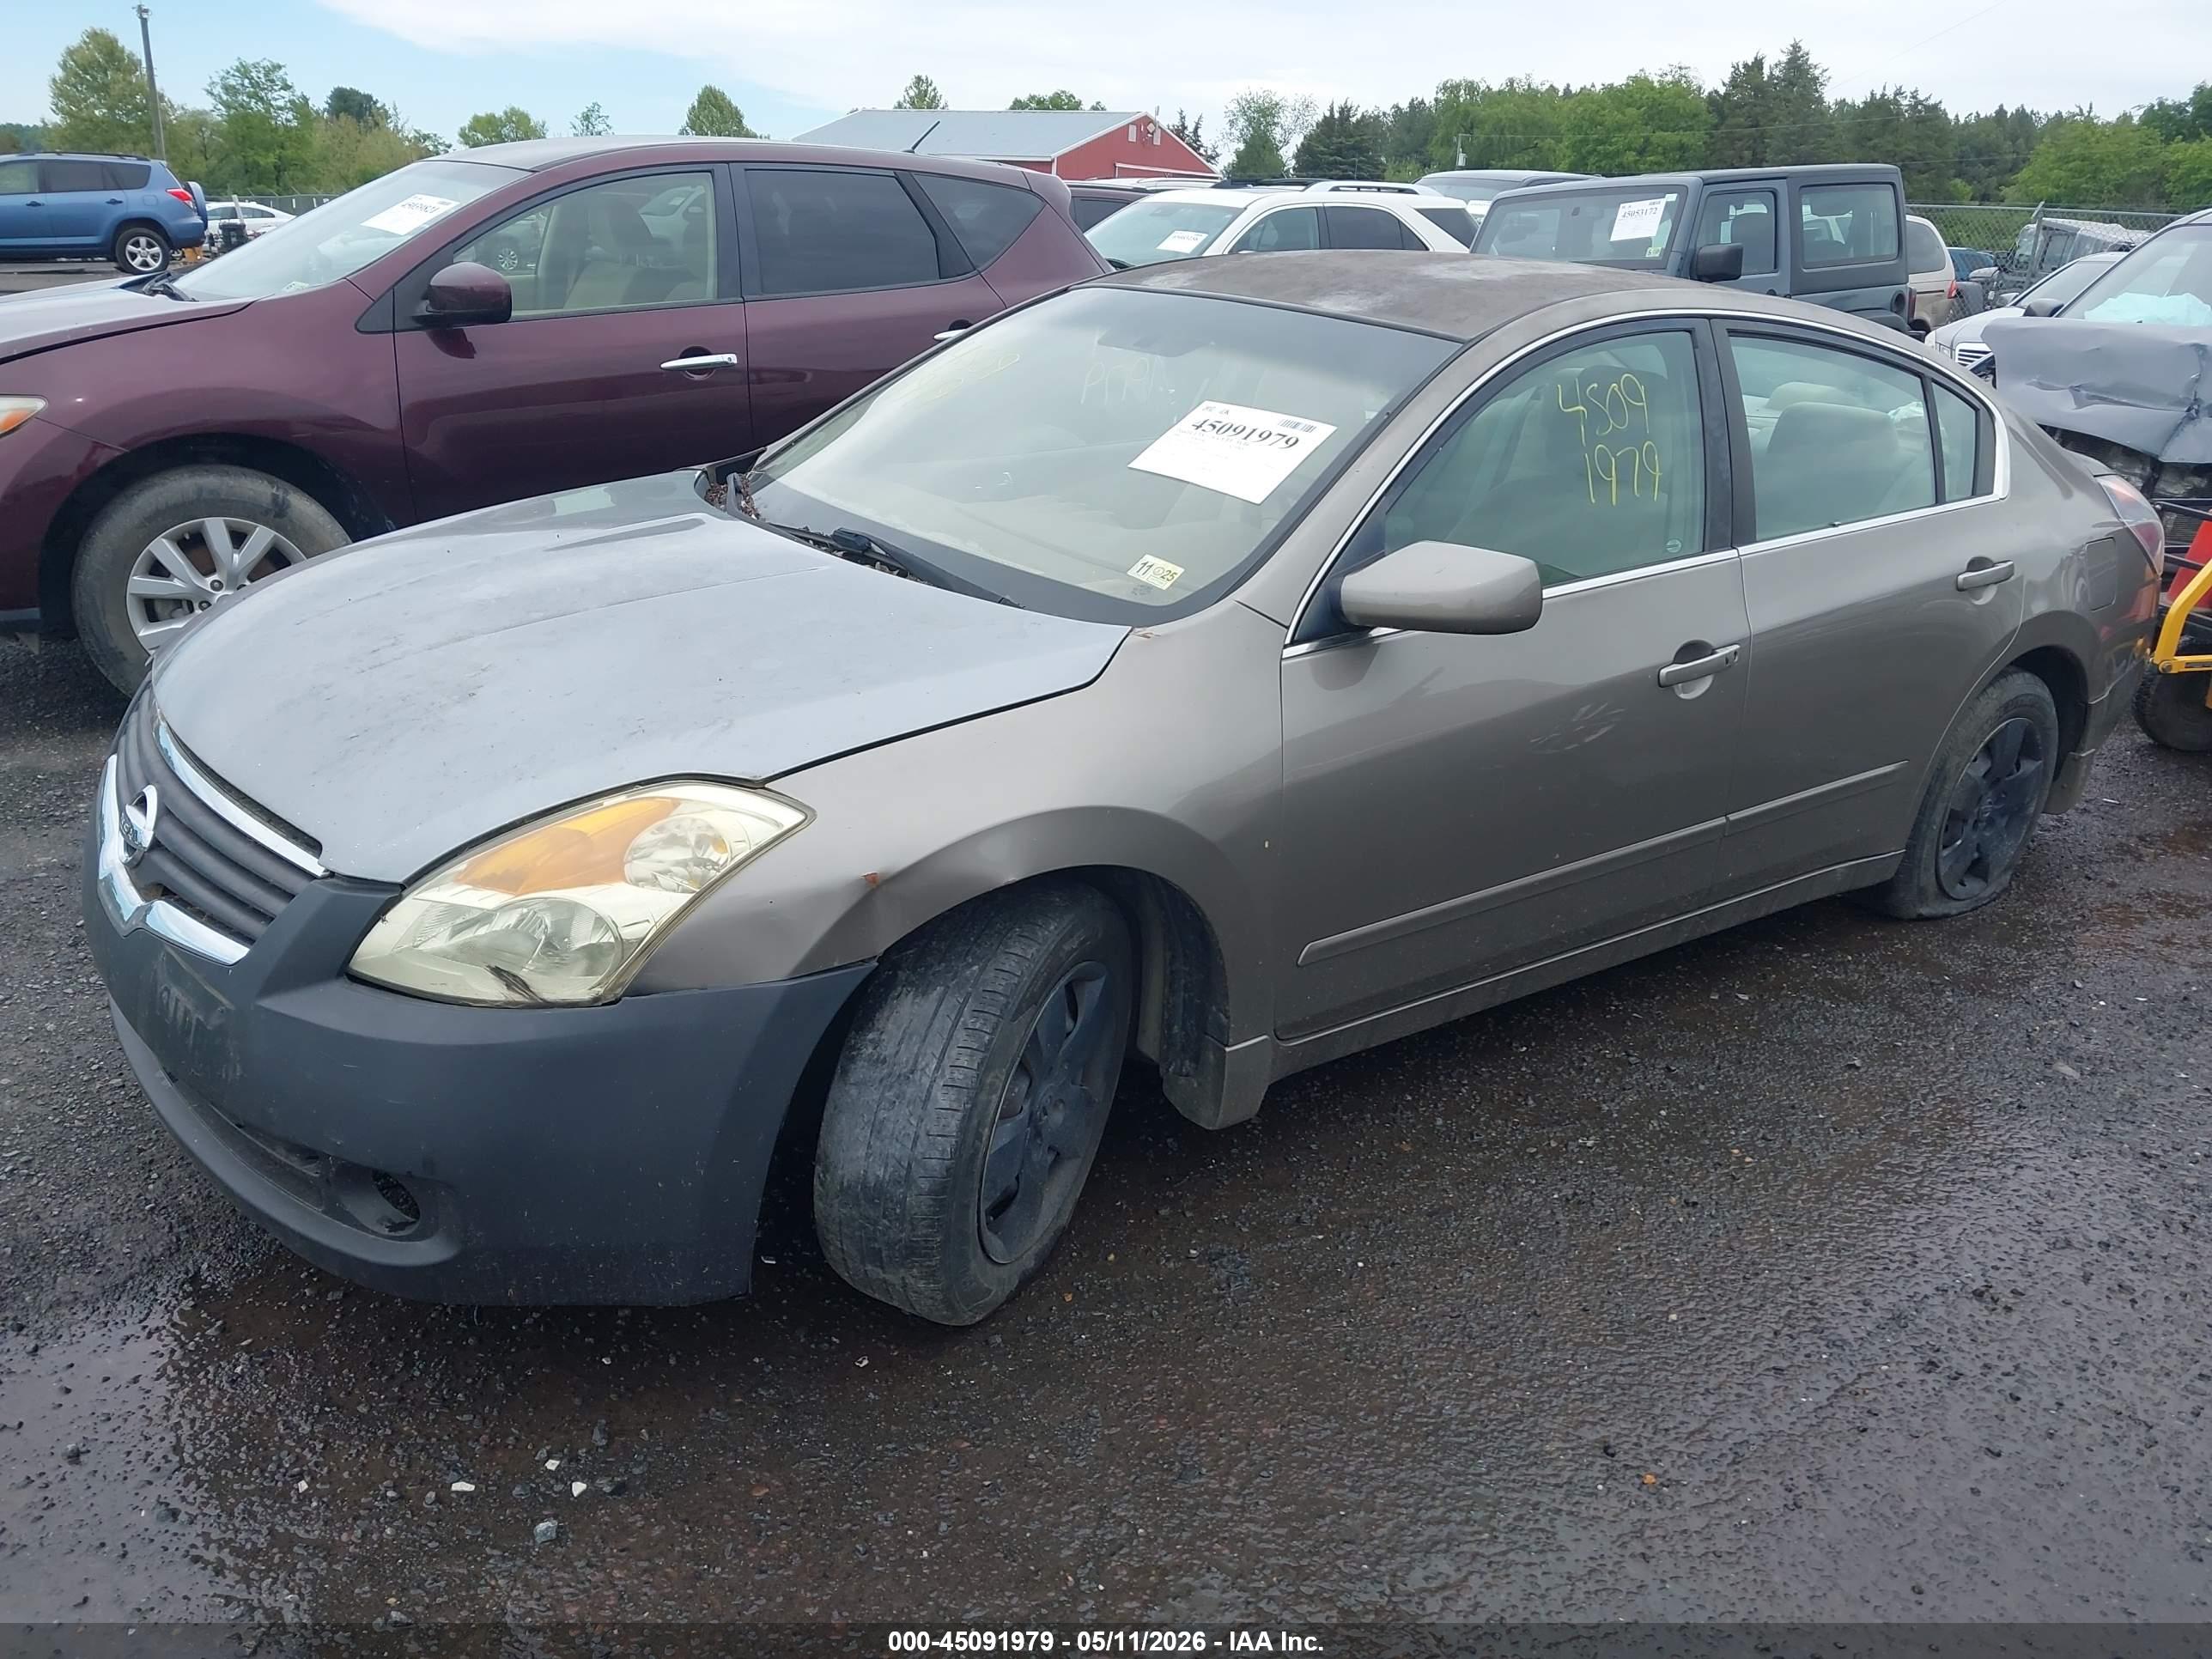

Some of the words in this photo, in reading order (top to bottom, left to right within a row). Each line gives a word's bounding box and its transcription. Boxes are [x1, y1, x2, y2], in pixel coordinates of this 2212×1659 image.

[1190, 418, 1300, 449] 45091979
[1557, 374, 1650, 447] 4509
[1584, 441, 1662, 506] 1979
[1136, 561, 1154, 576] 11
[1161, 569, 1177, 582] 25
